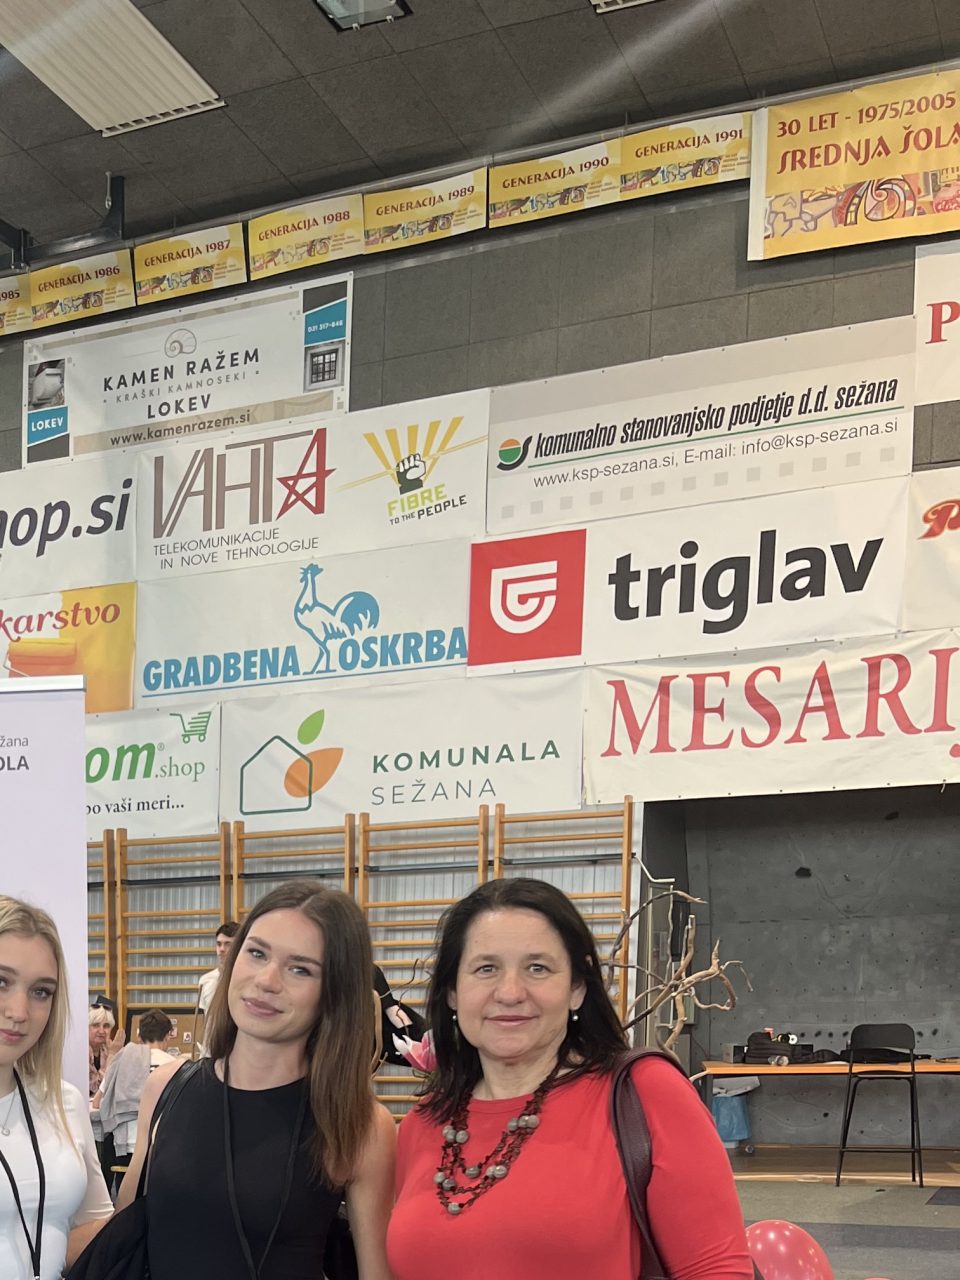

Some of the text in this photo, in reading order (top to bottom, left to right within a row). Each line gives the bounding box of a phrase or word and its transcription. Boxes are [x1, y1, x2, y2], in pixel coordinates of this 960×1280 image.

[777, 119, 801, 138] 30
[809, 112, 838, 132] LET
[858, 91, 956, 124] 1975/2005
[635, 129, 743, 158] GENERACIJA 1991
[777, 136, 891, 174] SREDNJA
[899, 122, 960, 154] ŠOLA
[502, 157, 609, 189] GENERACIJA 1990
[376, 185, 475, 216] GENERACIJA 1989
[258, 211, 350, 241] GENERACIJA 1988
[144, 240, 231, 267] GENERACIJA 1987
[38, 266, 120, 293] GENERACIJA 1986
[103, 347, 260, 392] KAMEN RAŽEM
[116, 372, 246, 404] KRAŠKI KAMNOSEKI
[147, 393, 213, 419] LOKEV
[534, 378, 899, 459] komunalno stanovanjsko podjetje d.d. sežana
[31, 416, 64, 432] LOKEV
[110, 409, 251, 446] www.kamenrazem.si
[685, 443, 737, 464] E-mail:
[741, 418, 899, 455] info@ksp-sezana.si
[387, 484, 447, 517] FIBRE
[390, 494, 467, 526] TO THE PEOPLE
[153, 528, 280, 557] TELEKOMUNIKACIJE
[160, 537, 319, 570] IN NOVE TEHNOLOGIJE
[608, 529, 884, 635] triglav
[143, 626, 468, 692] GRADBENA OSKRBA
[600, 647, 960, 759] MESARI
[372, 739, 561, 774] KOMUNALA
[105, 797, 132, 813] vaši
[371, 777, 497, 807] SEŽANA
